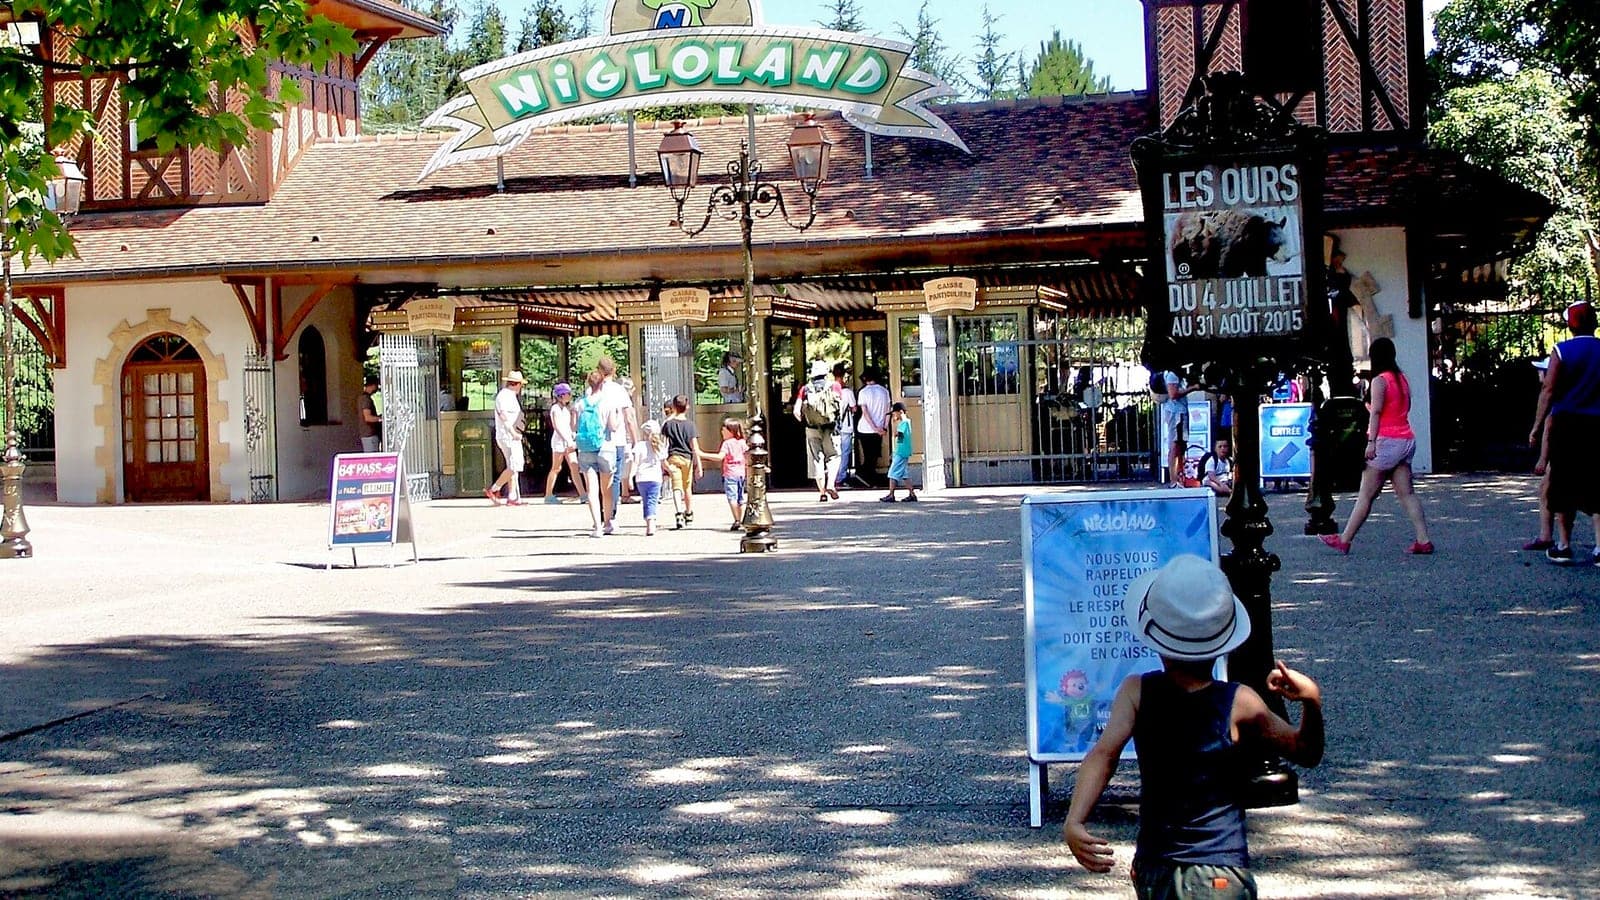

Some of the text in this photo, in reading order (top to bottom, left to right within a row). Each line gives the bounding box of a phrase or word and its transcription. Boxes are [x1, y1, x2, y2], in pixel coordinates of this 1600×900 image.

[655, 9, 686, 29] N
[1162, 164, 1298, 209] LES OURS
[936, 282, 963, 290] CAISSE
[1168, 277, 1302, 312] DU 4 JUILLET
[1171, 309, 1303, 337] AU 31 AOÛT 2015
[357, 462, 383, 473] PASS
[1086, 552, 1158, 565] NOUS VOUS
[1093, 584, 1119, 598] QUE
[1069, 601, 1084, 613] LE
[1090, 616, 1107, 628] DU
[1063, 632, 1092, 645] DOIT
[1095, 631, 1112, 644] SE
[1091, 648, 1107, 660] EN
